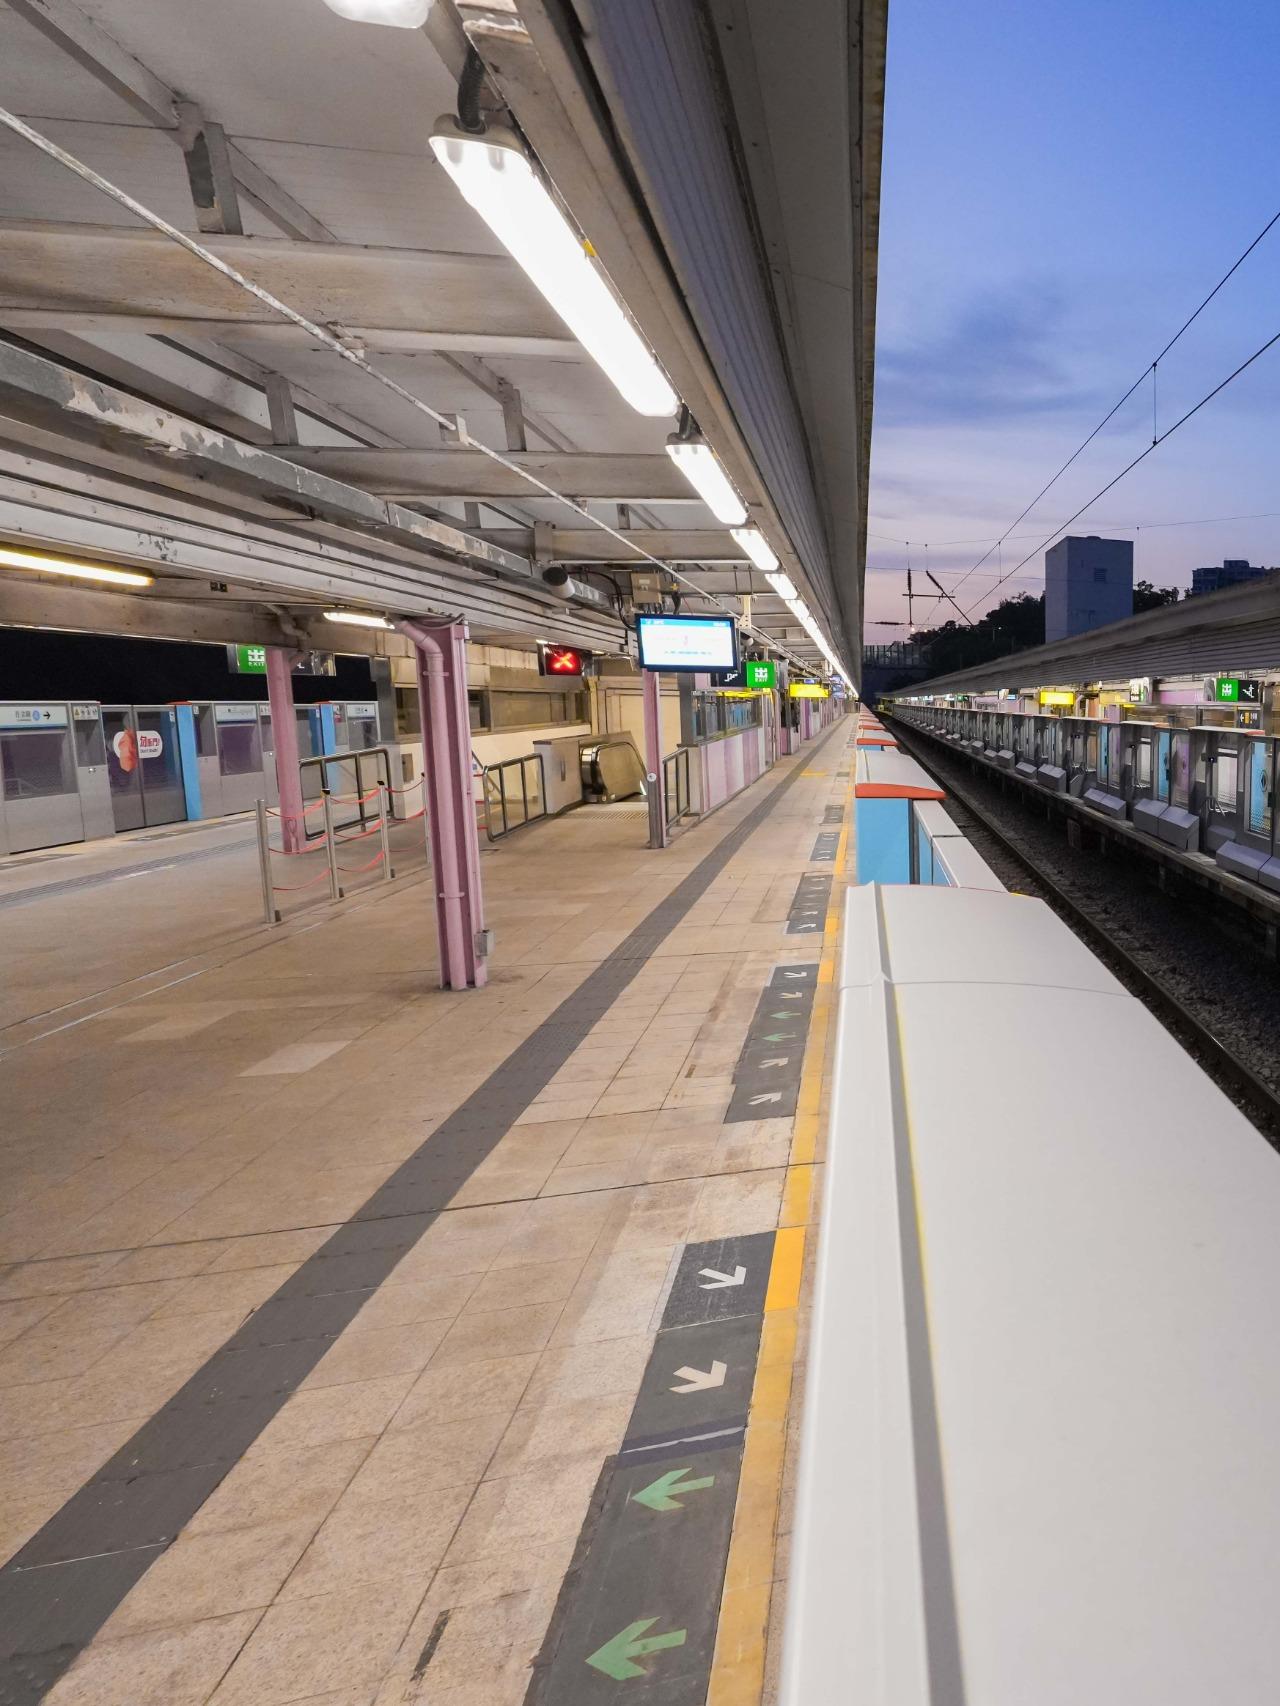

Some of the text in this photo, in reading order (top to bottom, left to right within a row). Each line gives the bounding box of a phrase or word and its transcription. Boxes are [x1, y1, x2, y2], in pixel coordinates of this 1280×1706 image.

[247, 649, 265, 662] 出
[754, 667, 768, 678] 出
[1221, 683, 1232, 693] 出
